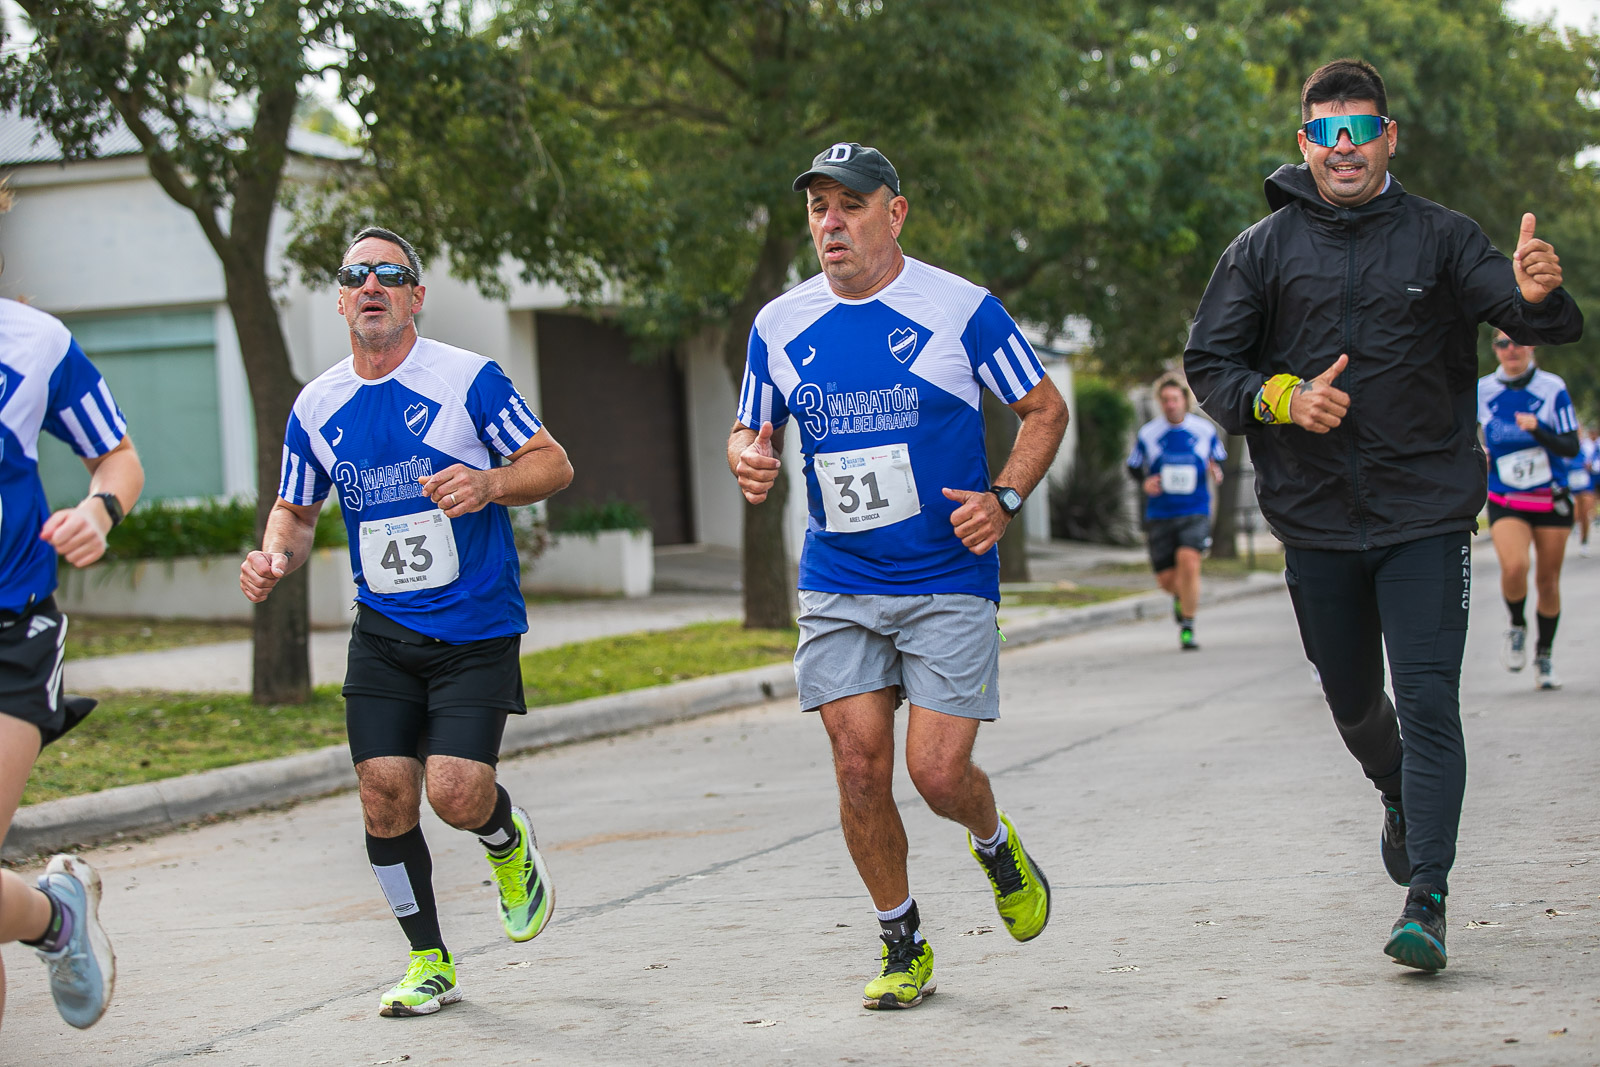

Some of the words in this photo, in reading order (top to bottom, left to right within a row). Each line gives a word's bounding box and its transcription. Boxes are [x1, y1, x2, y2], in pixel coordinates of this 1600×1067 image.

[826, 144, 851, 163] D
[796, 383, 829, 441] 3
[826, 383, 919, 417] MARATÓN
[335, 461, 363, 512] 3
[360, 455, 433, 492] MARATÓN
[834, 471, 889, 514] 31
[380, 534, 433, 575] 43
